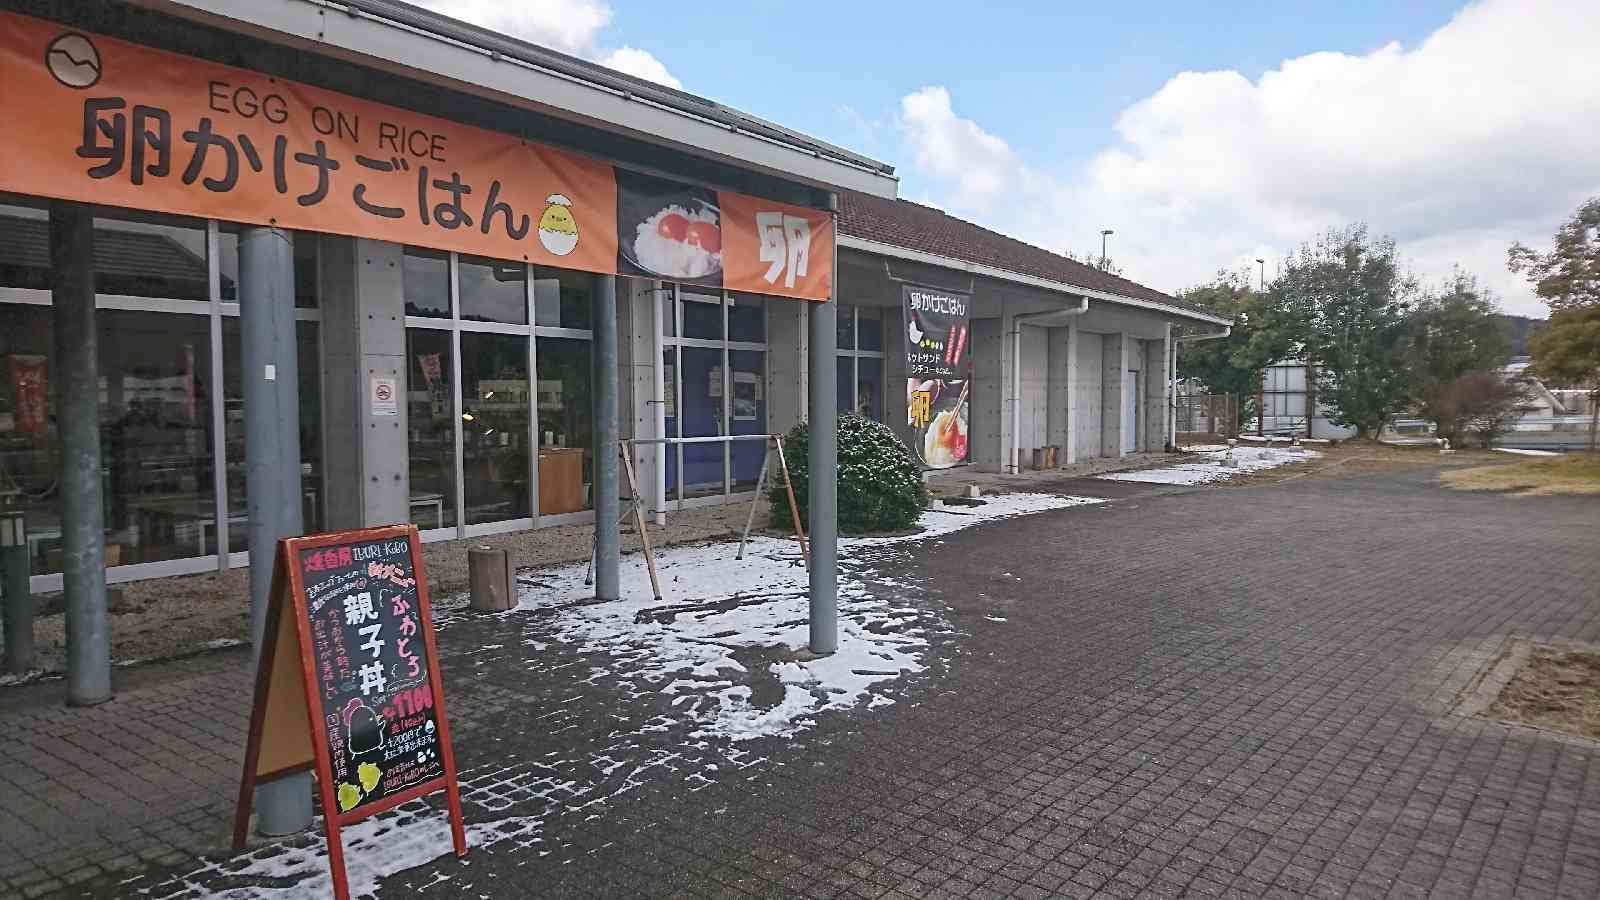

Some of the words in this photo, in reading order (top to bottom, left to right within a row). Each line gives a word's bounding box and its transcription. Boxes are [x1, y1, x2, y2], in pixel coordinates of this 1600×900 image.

[208, 80, 288, 124] EGG
[311, 106, 359, 143] ON
[379, 122, 447, 162] RICE
[75, 96, 530, 241] 卵かけごはん
[756, 212, 811, 289] 卵
[911, 292, 965, 316] 卵かけごはん
[343, 591, 387, 696] 親子丼
[391, 595, 420, 677] ふわとろ
